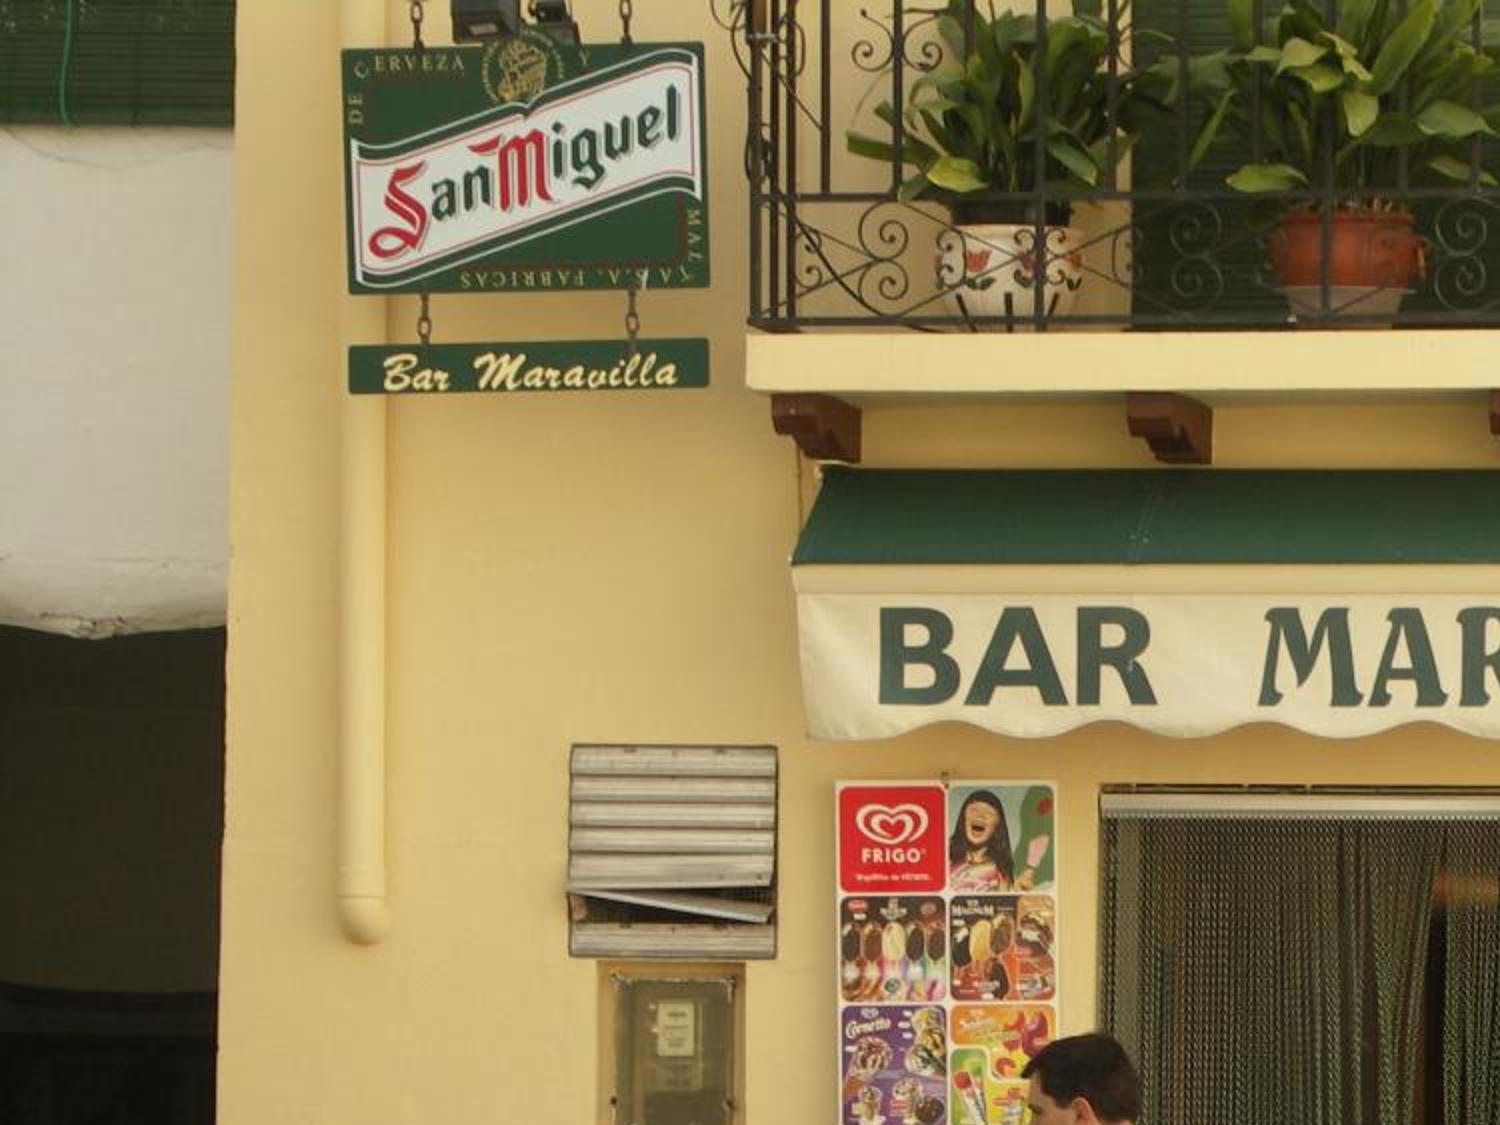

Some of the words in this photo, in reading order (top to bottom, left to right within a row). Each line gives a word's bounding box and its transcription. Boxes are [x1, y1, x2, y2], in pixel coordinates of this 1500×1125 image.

[353, 54, 465, 79] CERVEZA
[383, 354, 449, 392] Bar
[474, 353, 679, 389] Maravilla
[878, 605, 1158, 706] BAR
[861, 847, 921, 864] FRIGO
